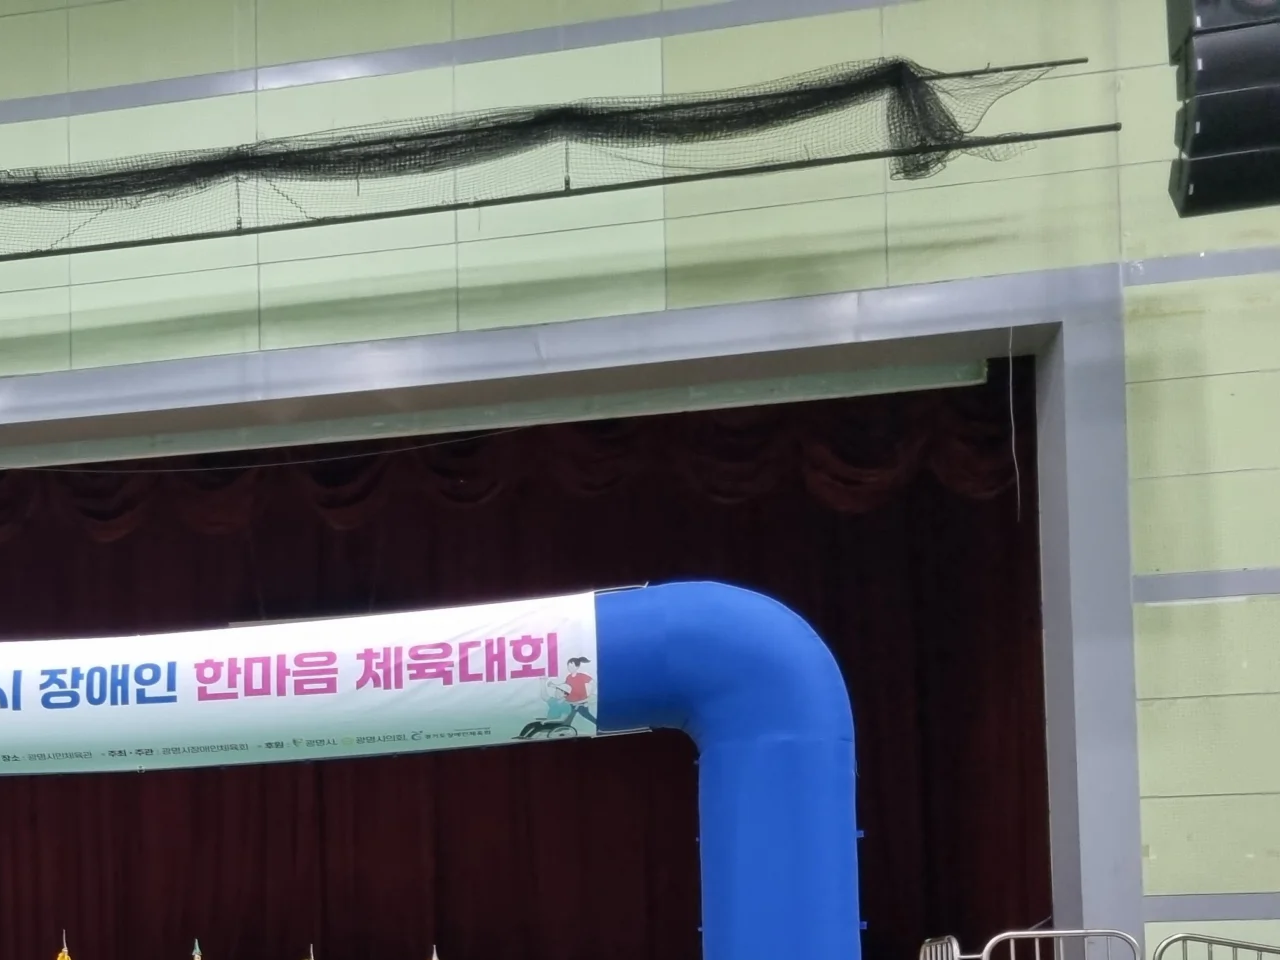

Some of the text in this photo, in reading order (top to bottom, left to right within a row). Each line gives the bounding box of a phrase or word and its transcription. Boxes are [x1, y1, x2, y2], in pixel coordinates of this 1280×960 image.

[39, 661, 178, 709] 장애인
[194, 651, 338, 701] 한마음
[356, 632, 559, 690] 체육대회
